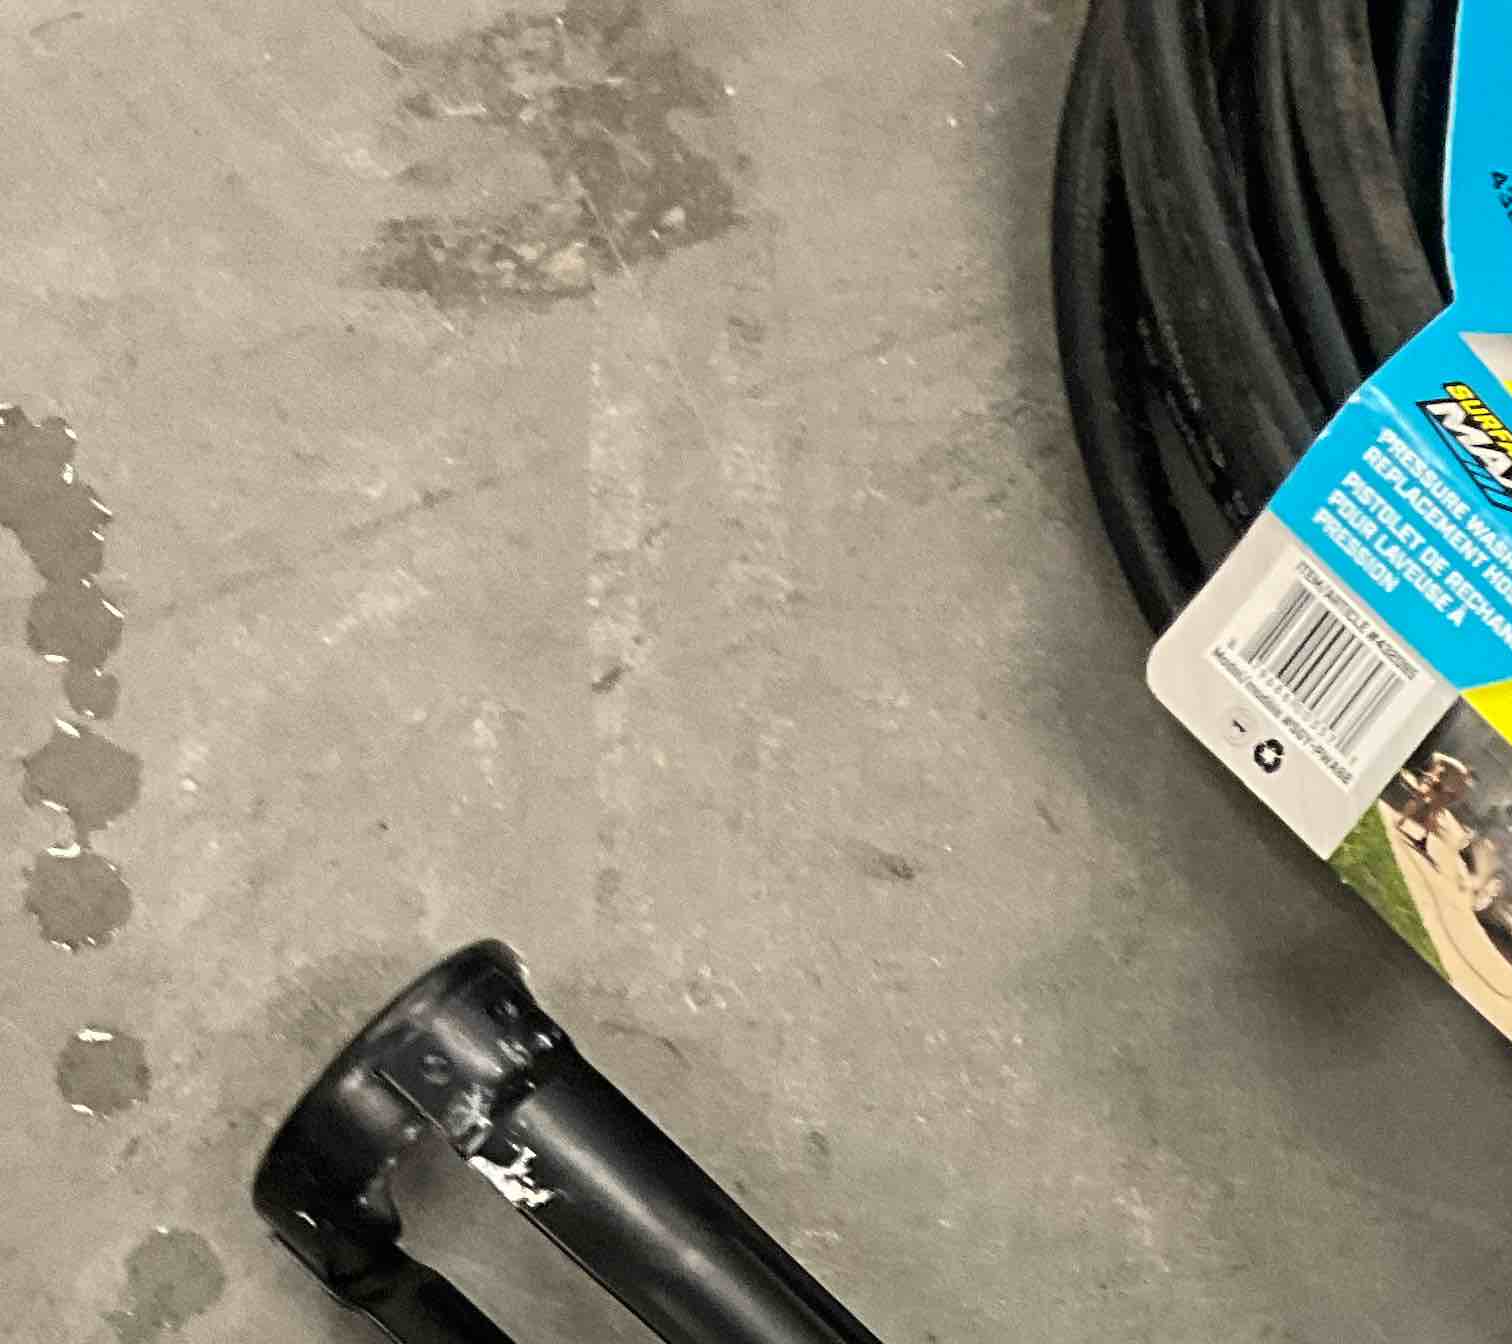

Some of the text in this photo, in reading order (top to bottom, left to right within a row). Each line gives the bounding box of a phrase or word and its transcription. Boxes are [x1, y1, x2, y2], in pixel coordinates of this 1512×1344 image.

[1341, 471, 1427, 551] PISTOLET
[1420, 546, 1450, 577] DE
[1361, 445, 1489, 568] REPLACEMENT
[1377, 426, 1471, 520] PRESSURE
[1312, 506, 1401, 593] PRESSION
[1327, 488, 1378, 541] POUR
[1373, 534, 1455, 613] LAVEUSE
